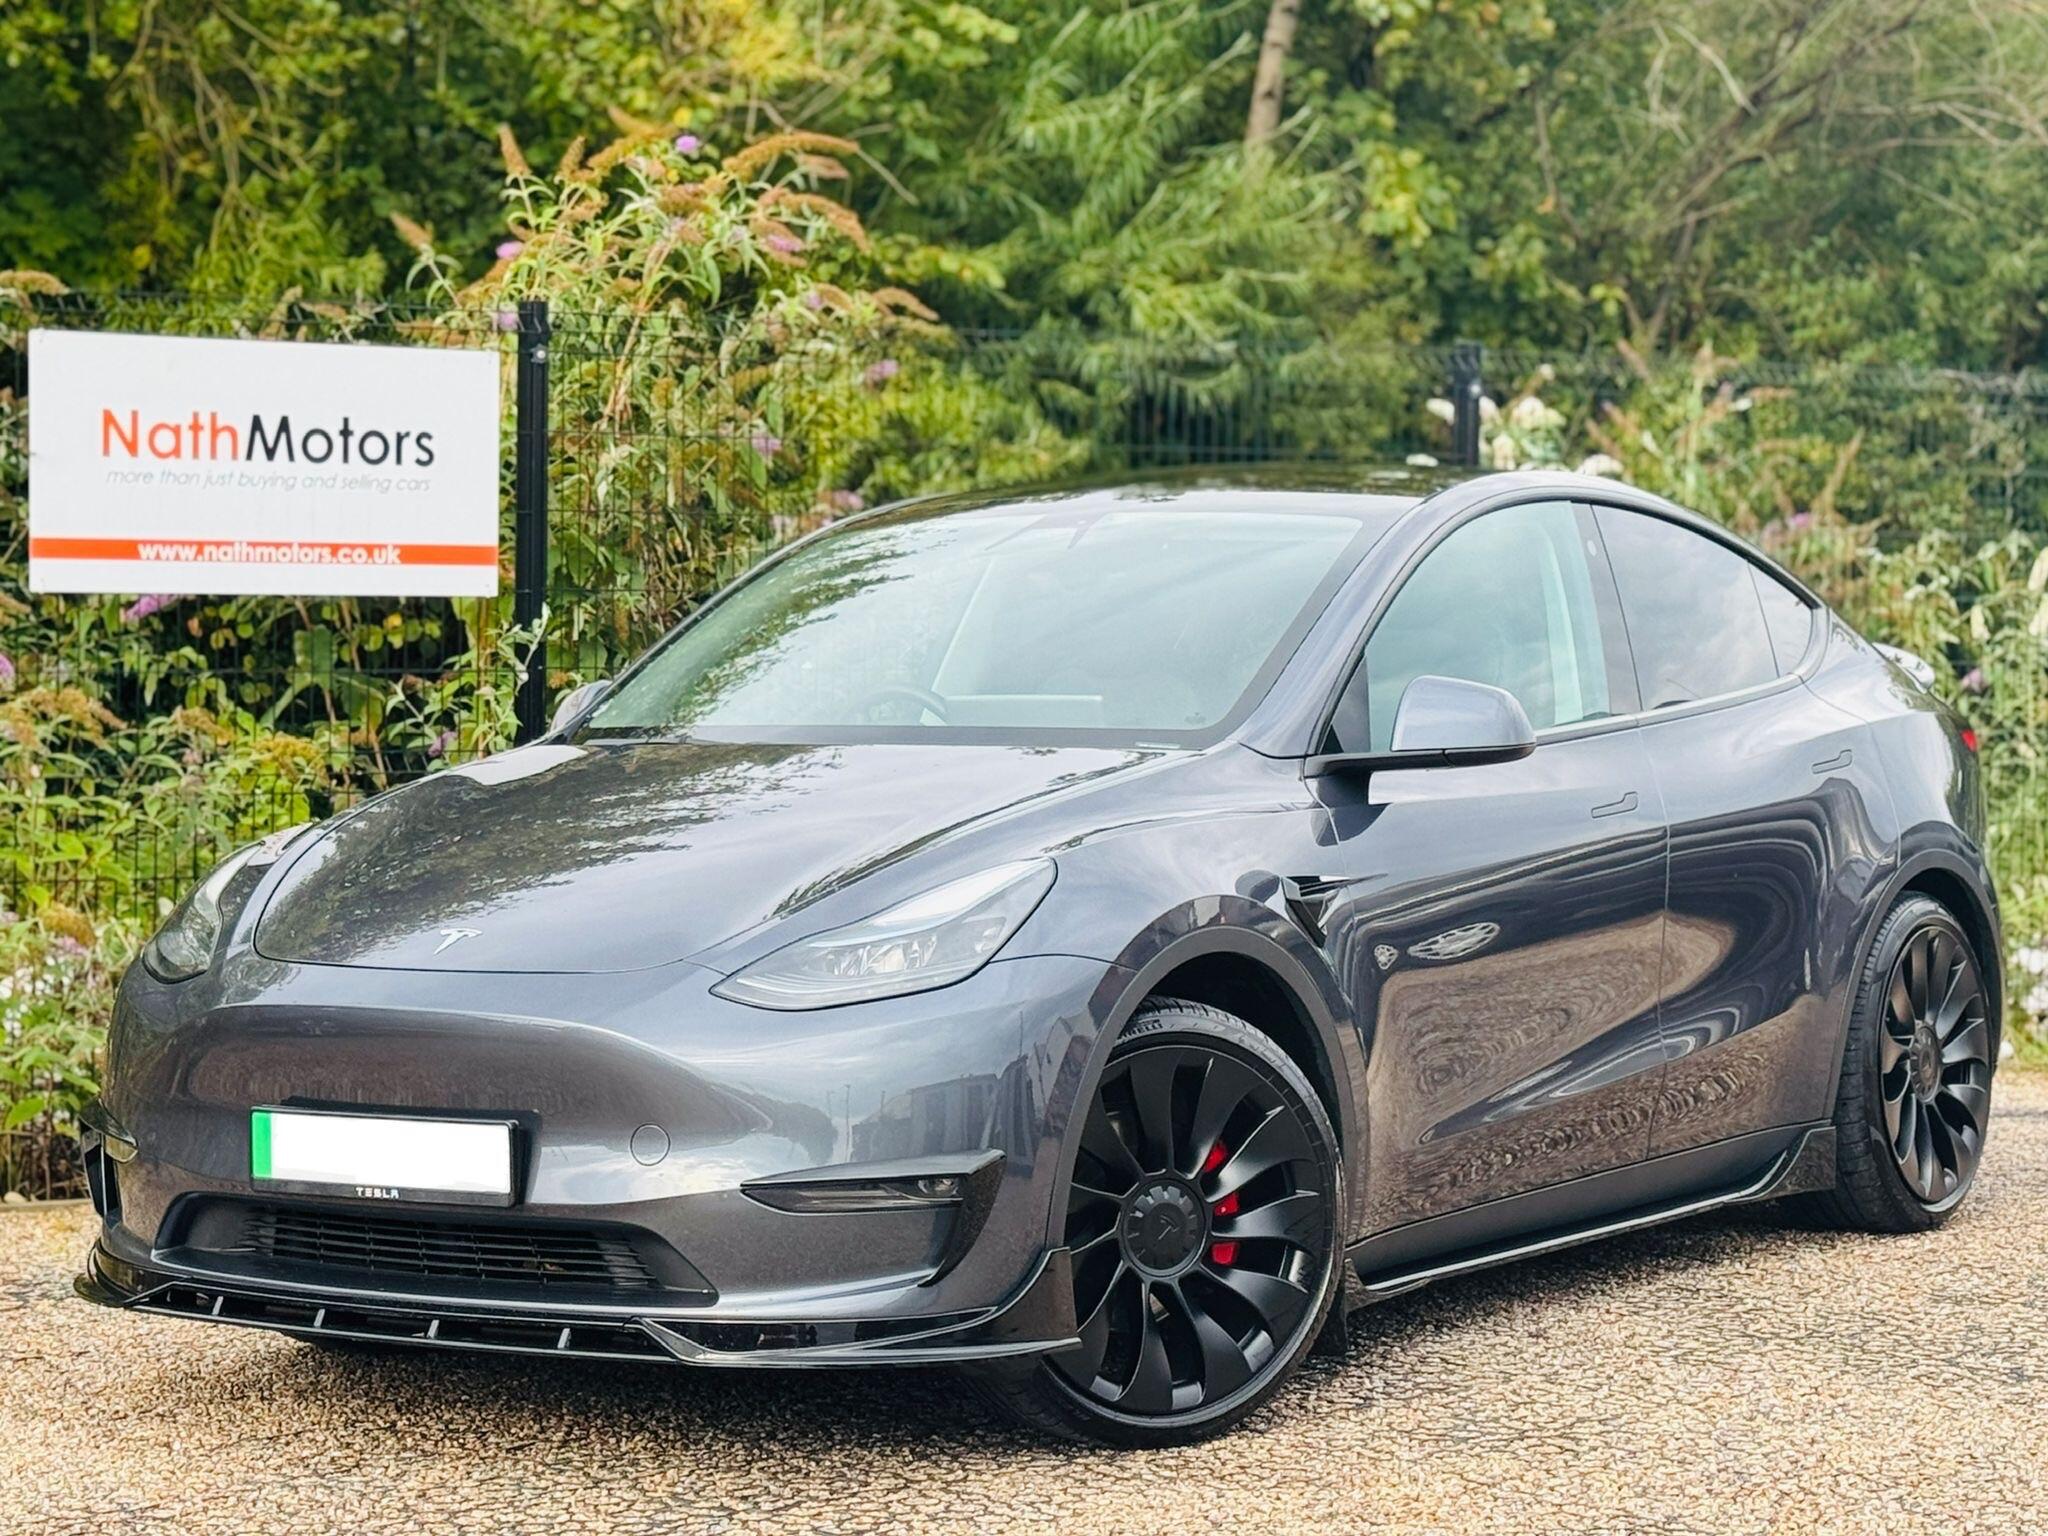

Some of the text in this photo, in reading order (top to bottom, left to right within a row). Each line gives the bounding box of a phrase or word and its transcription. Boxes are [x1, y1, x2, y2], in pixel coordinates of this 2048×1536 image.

[102, 409, 434, 467] NathMotors
[106, 469, 431, 493] more than just buying and selling cars
[138, 542, 401, 565] www.nathmotors.co.uk
[355, 1186, 399, 1199] TESLA
